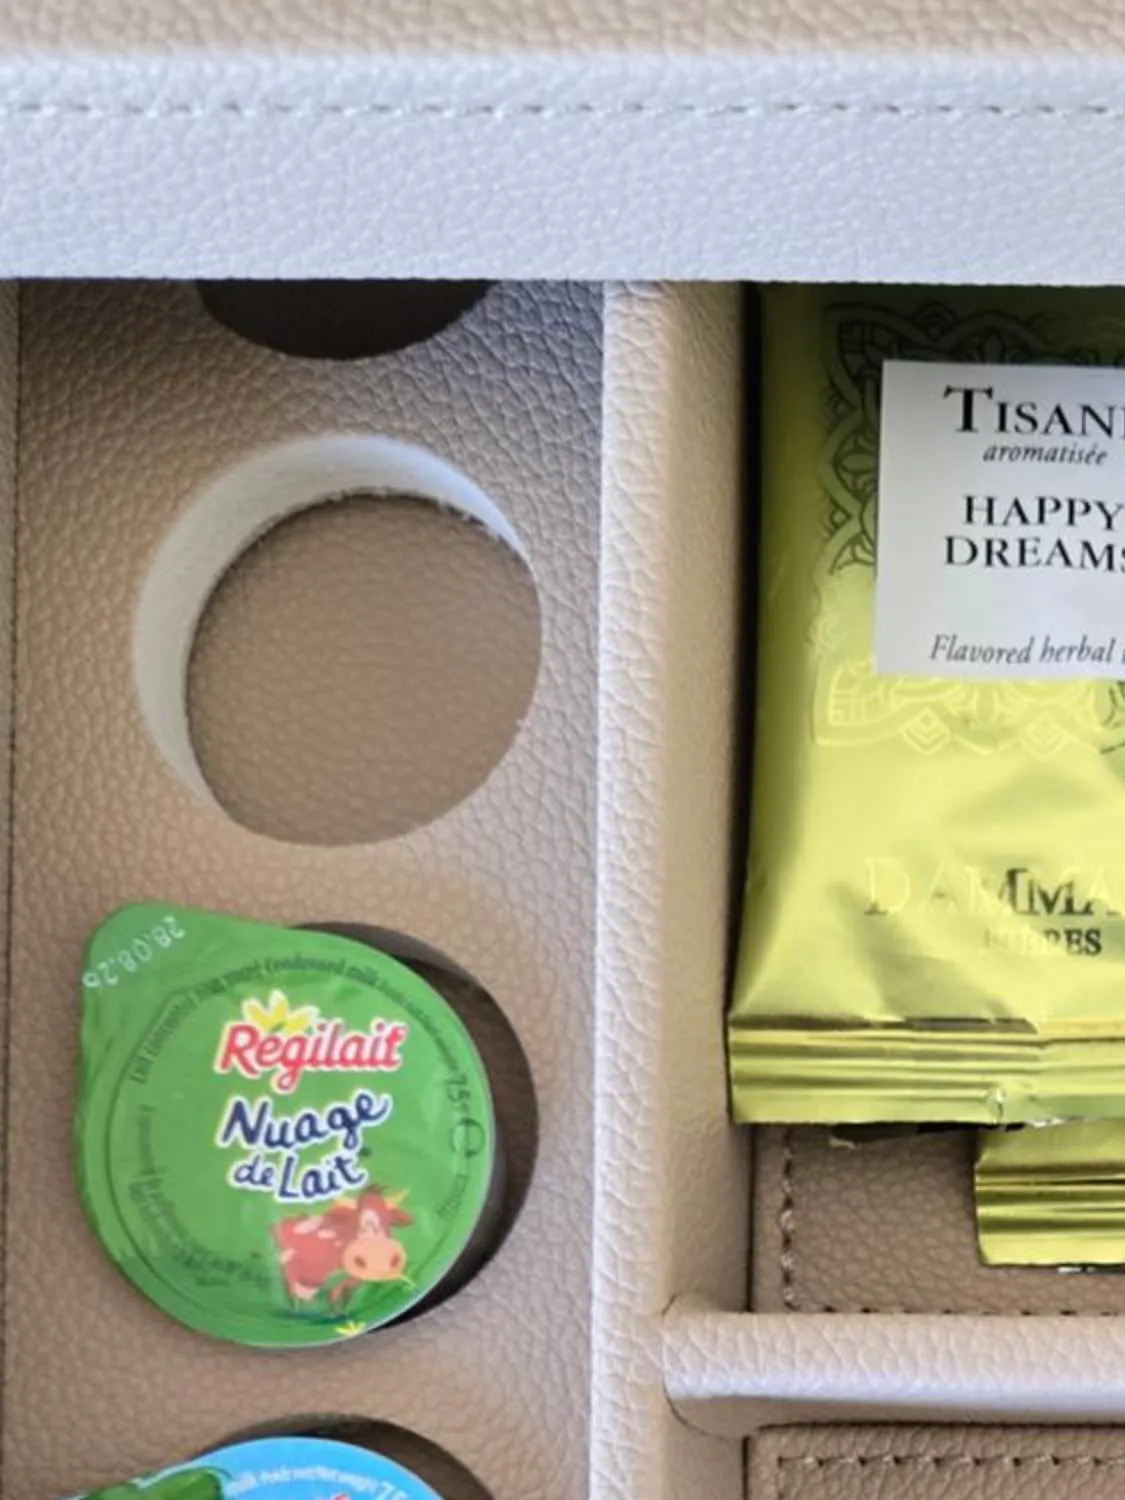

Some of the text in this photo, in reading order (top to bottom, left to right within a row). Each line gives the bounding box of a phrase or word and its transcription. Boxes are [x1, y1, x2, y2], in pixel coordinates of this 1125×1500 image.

[982, 440, 1108, 466] aromatisée
[962, 494, 1125, 531] HAPPY
[930, 633, 1036, 664] Flavored
[1038, 634, 1117, 664] herbal
[221, 1092, 387, 1150] Nuage
[233, 1155, 364, 1199] de Lait
